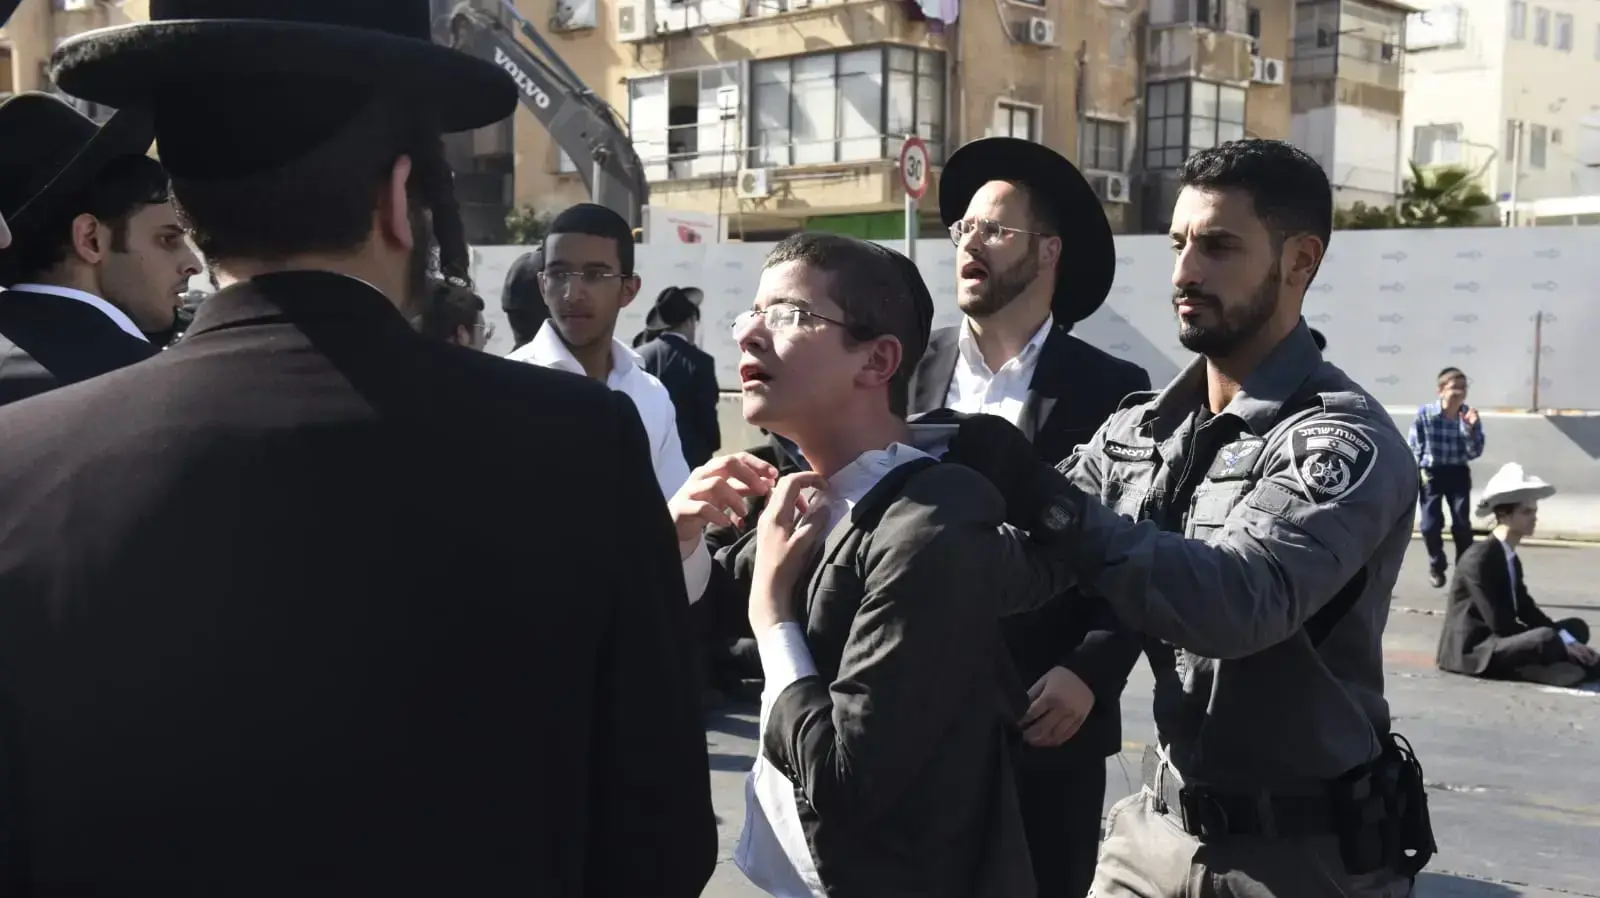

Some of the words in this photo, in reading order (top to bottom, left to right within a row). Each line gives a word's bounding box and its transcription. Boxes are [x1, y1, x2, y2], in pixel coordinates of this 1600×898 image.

[494, 46, 550, 109] VOLVO
[906, 155, 922, 181] 30
[1298, 426, 1334, 437] ישראל
[1334, 428, 1370, 452] משטרת
